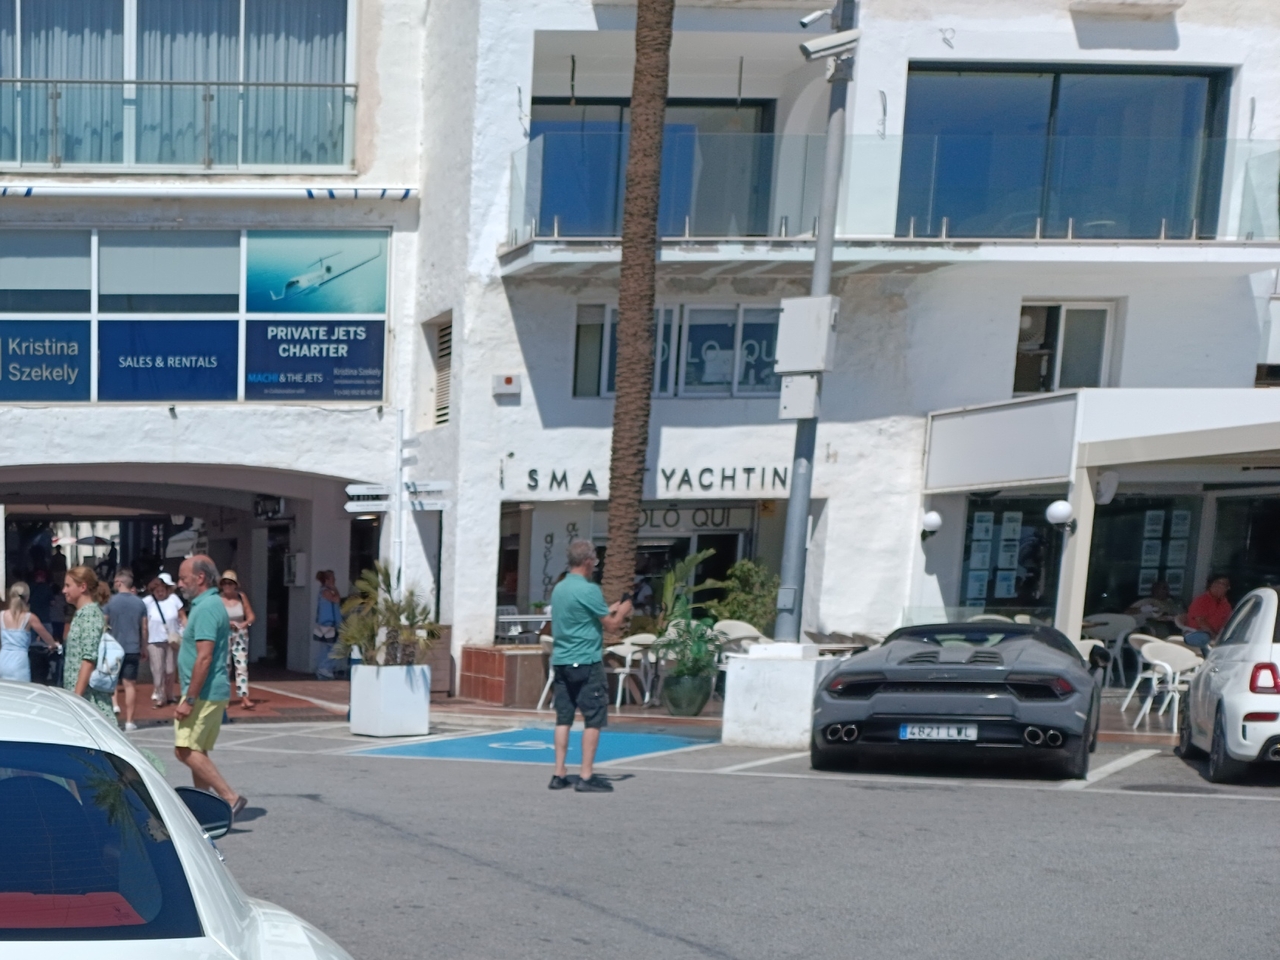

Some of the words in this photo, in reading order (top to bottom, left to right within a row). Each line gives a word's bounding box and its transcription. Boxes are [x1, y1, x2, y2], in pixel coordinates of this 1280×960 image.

[267, 326, 328, 340] PRIVATE
[330, 326, 366, 340] JETS
[7, 338, 79, 356] Kristina
[278, 344, 348, 357] CHARTER
[742, 339, 778, 365] QU
[119, 357, 153, 368] SALES
[154, 357, 165, 368] &
[167, 357, 218, 368] RENTALS
[7, 363, 80, 385] Szekely
[287, 373, 303, 383] THE
[304, 373, 324, 383] JETS
[661, 467, 788, 491] YACHTIN
[692, 507, 730, 528] QUI
[909, 726, 940, 738] 4821
